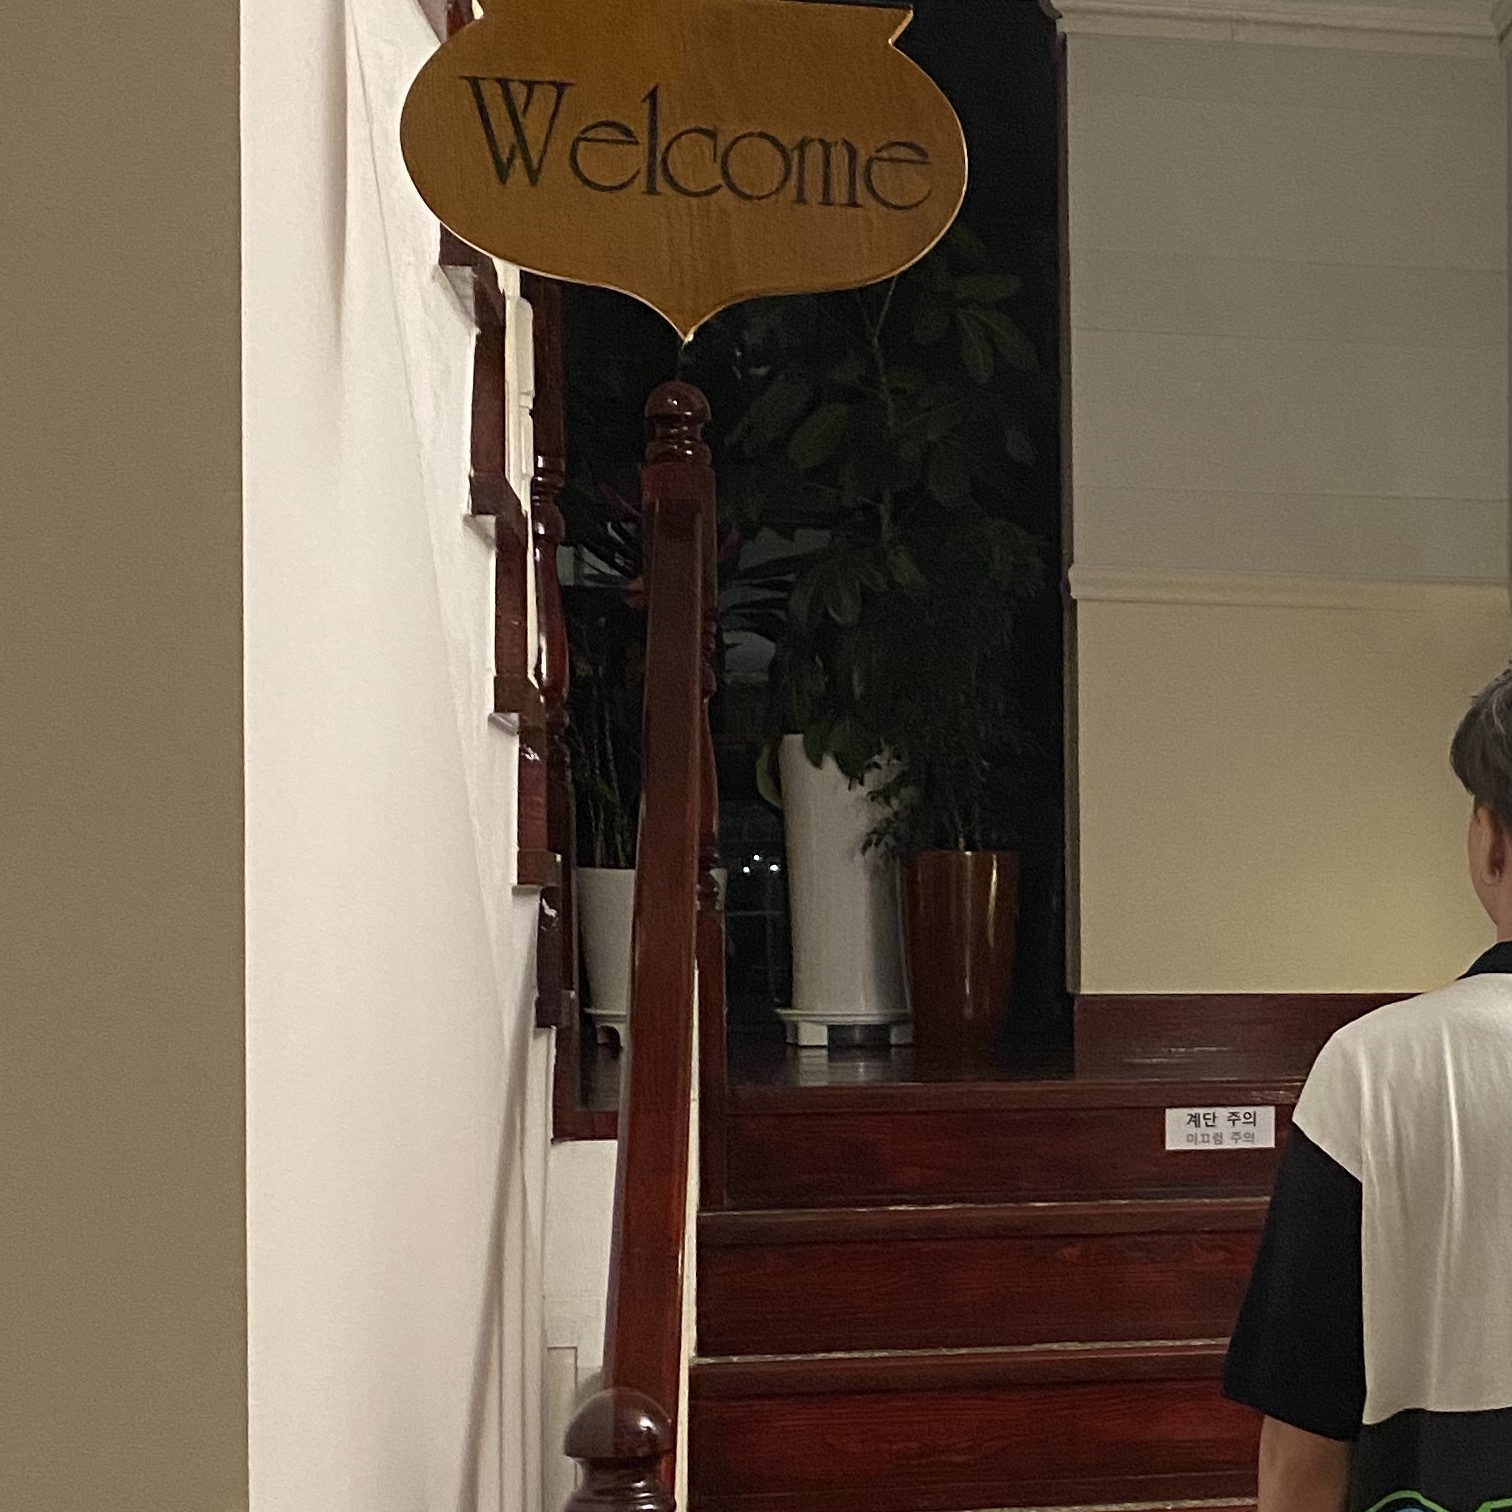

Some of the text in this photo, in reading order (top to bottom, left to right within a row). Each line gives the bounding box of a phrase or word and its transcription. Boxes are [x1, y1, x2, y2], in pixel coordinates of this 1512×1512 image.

[459, 74, 933, 212] Welcome
[1186, 1110, 1257, 1128] 계단 주의
[1186, 1131, 1255, 1145] 미끄럼 주의
